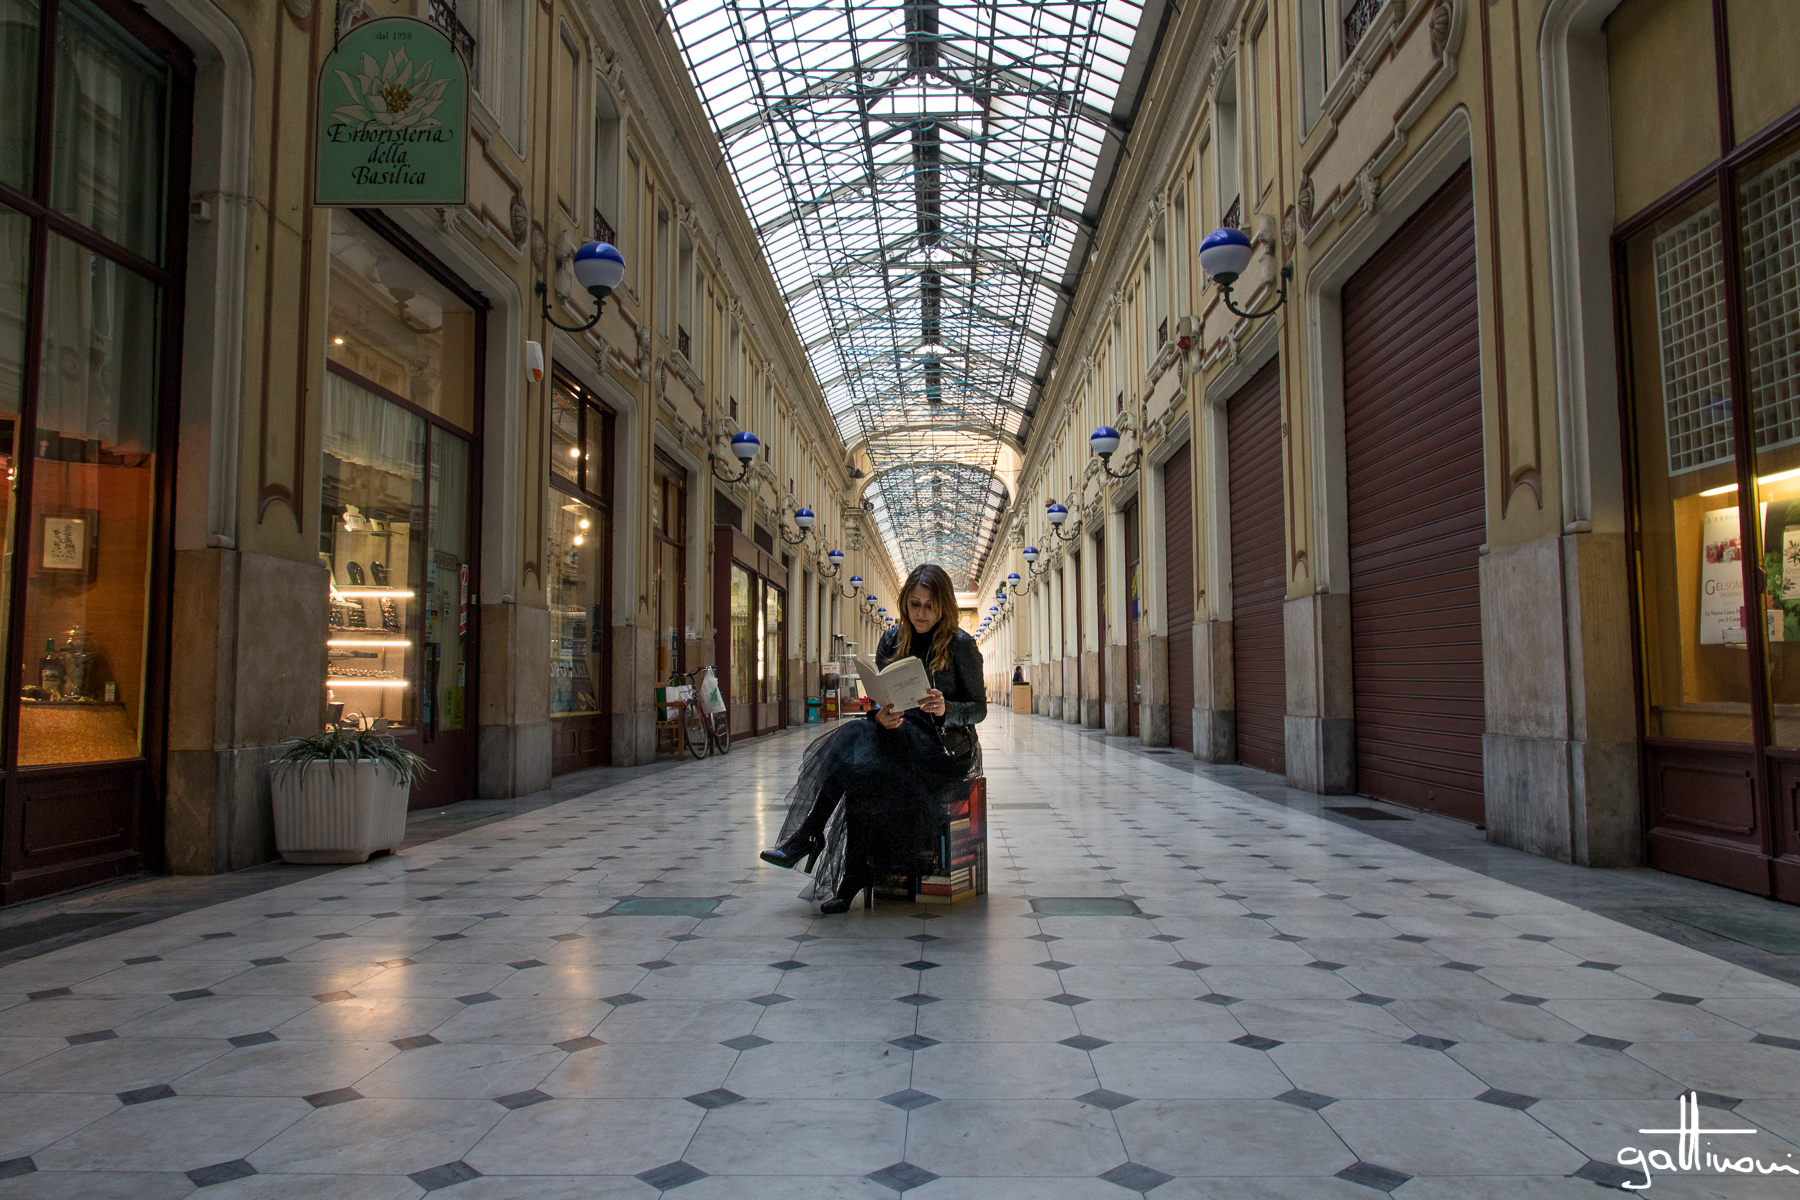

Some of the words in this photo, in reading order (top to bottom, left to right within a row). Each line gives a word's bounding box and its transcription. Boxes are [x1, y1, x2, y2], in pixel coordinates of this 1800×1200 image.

[376, 31, 389, 40] dal
[392, 31, 413, 40] 1958
[327, 119, 454, 143] Erboristeria
[367, 142, 408, 164] della
[351, 164, 426, 185] Basilica
